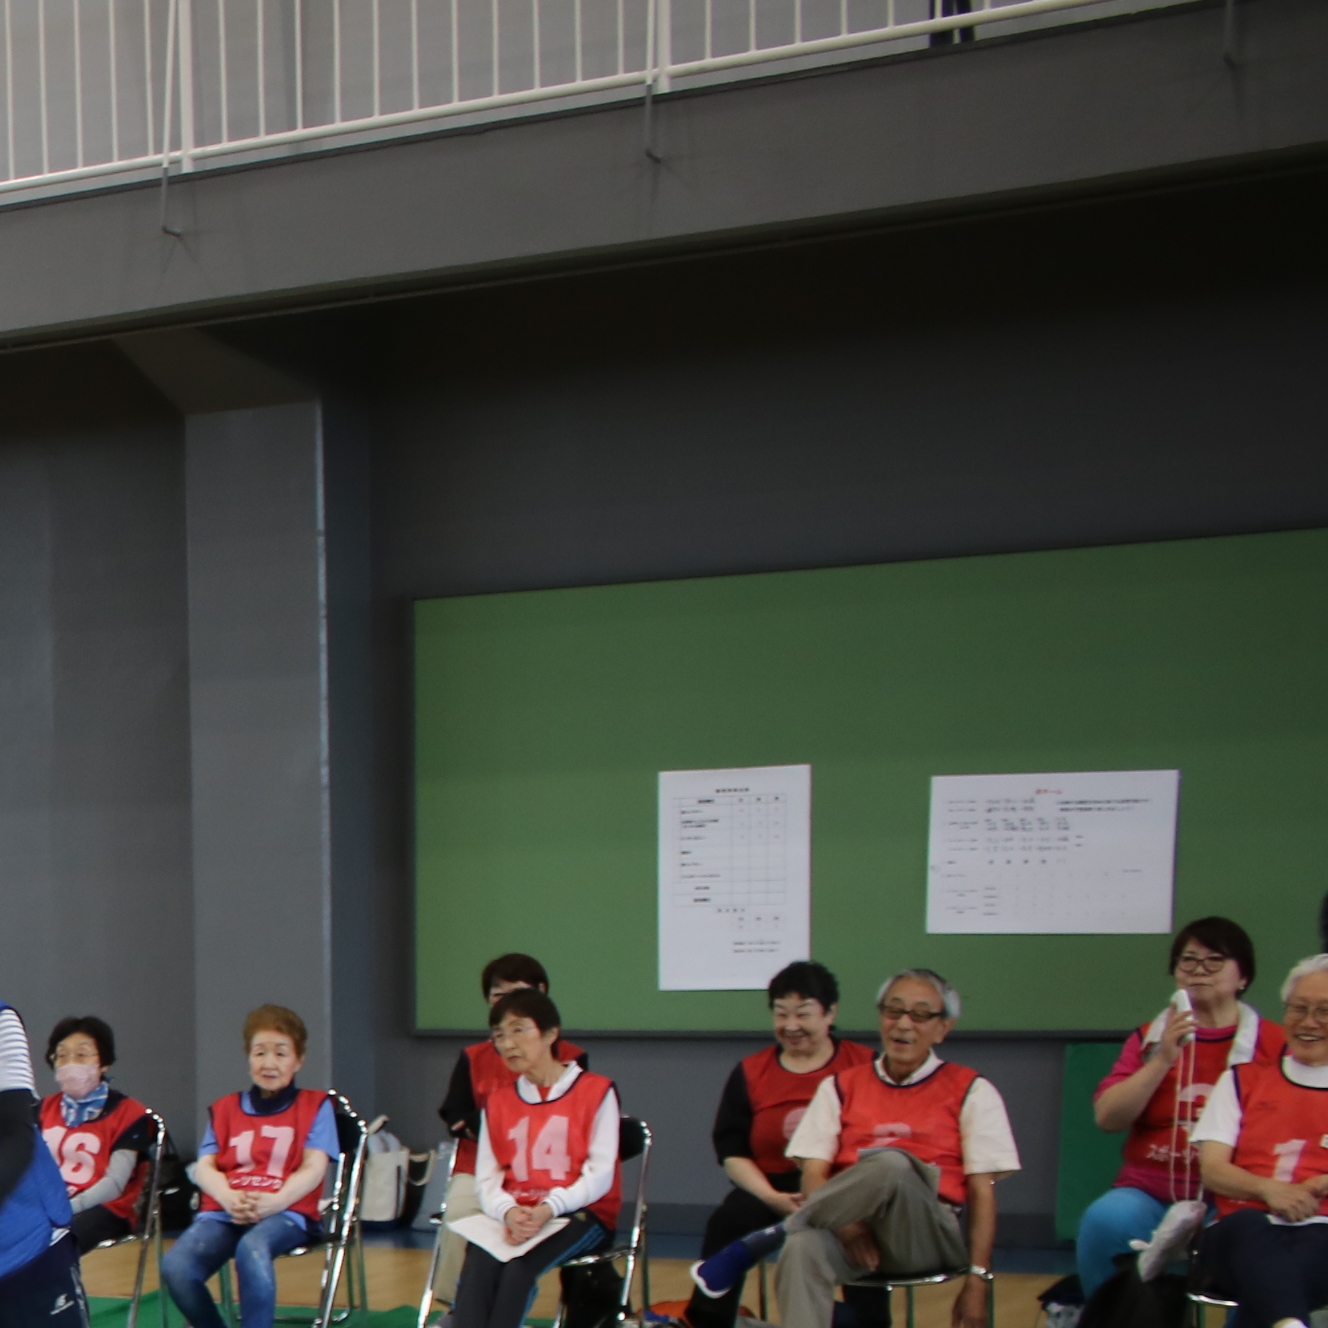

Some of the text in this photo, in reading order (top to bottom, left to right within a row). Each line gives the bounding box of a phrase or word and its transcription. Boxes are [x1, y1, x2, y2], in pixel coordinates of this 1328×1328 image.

[42, 1125, 101, 1185] 16
[228, 1124, 295, 1178] 17
[508, 1114, 572, 1183] 14
